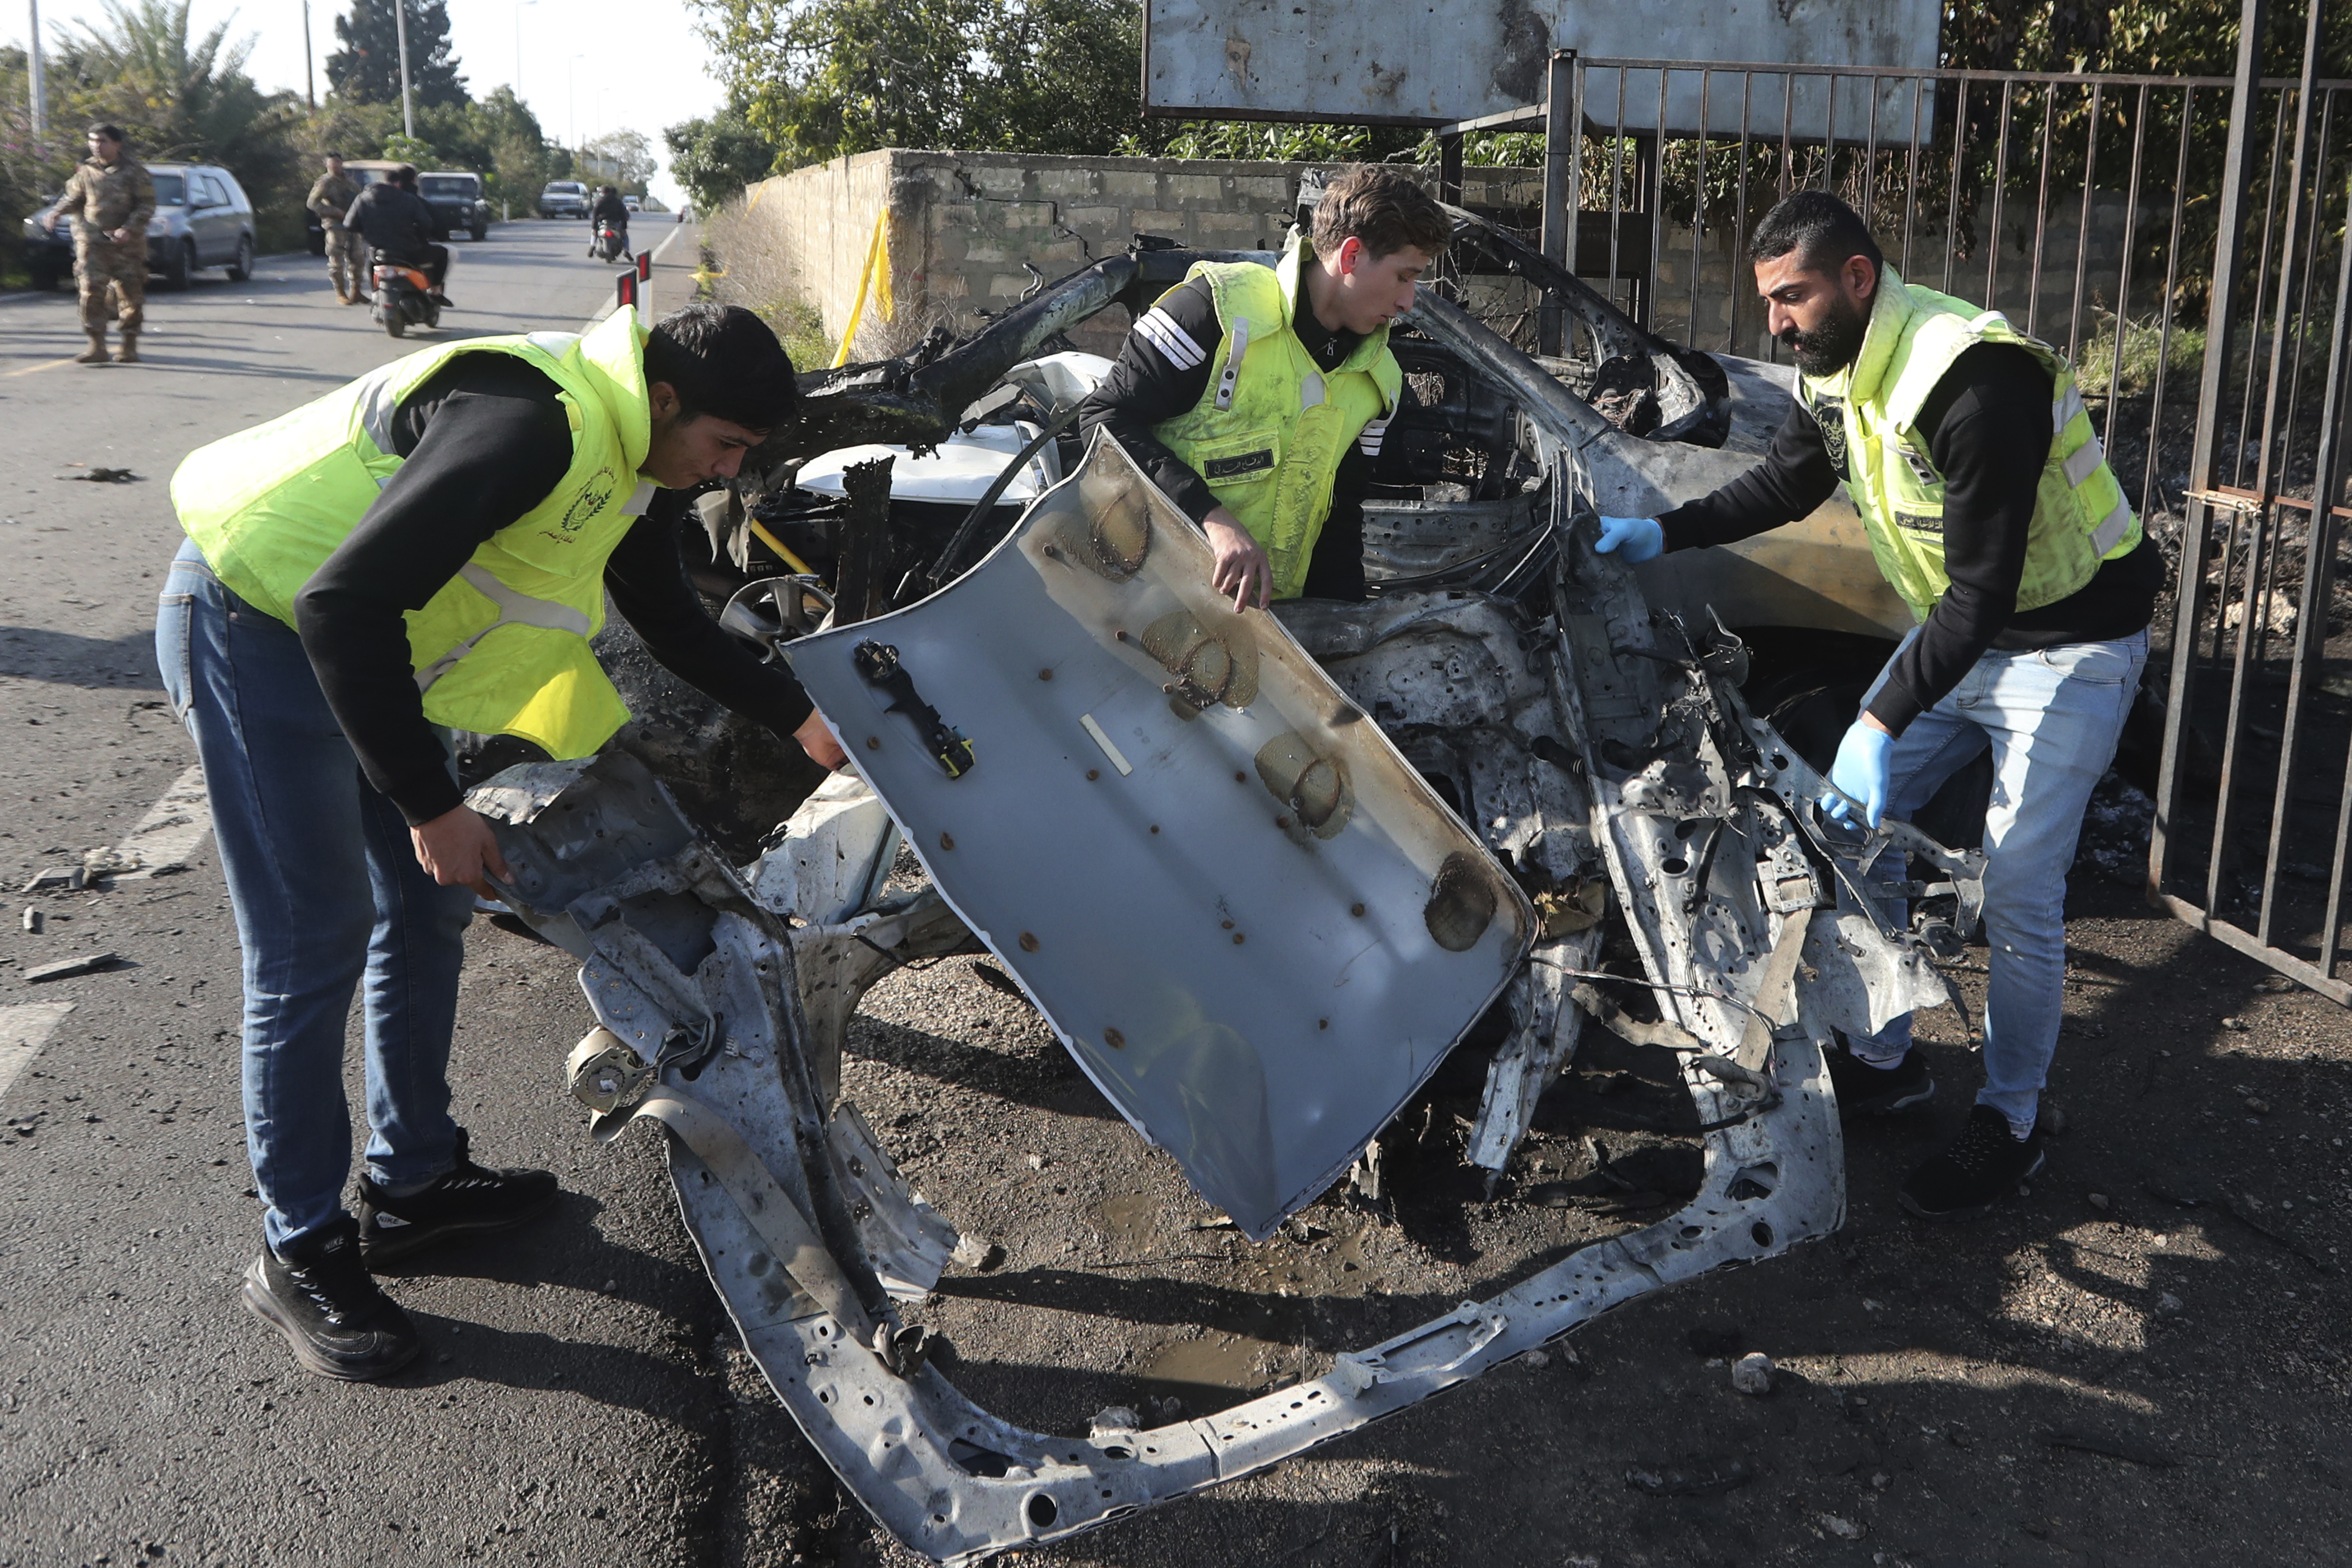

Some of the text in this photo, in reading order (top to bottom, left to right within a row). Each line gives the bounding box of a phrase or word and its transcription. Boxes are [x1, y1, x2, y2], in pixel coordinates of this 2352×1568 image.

[1214, 455, 1264, 475] الدفاع المدني
[378, 1216, 399, 1225] NIKE
[324, 1235, 344, 1251] NIKE
